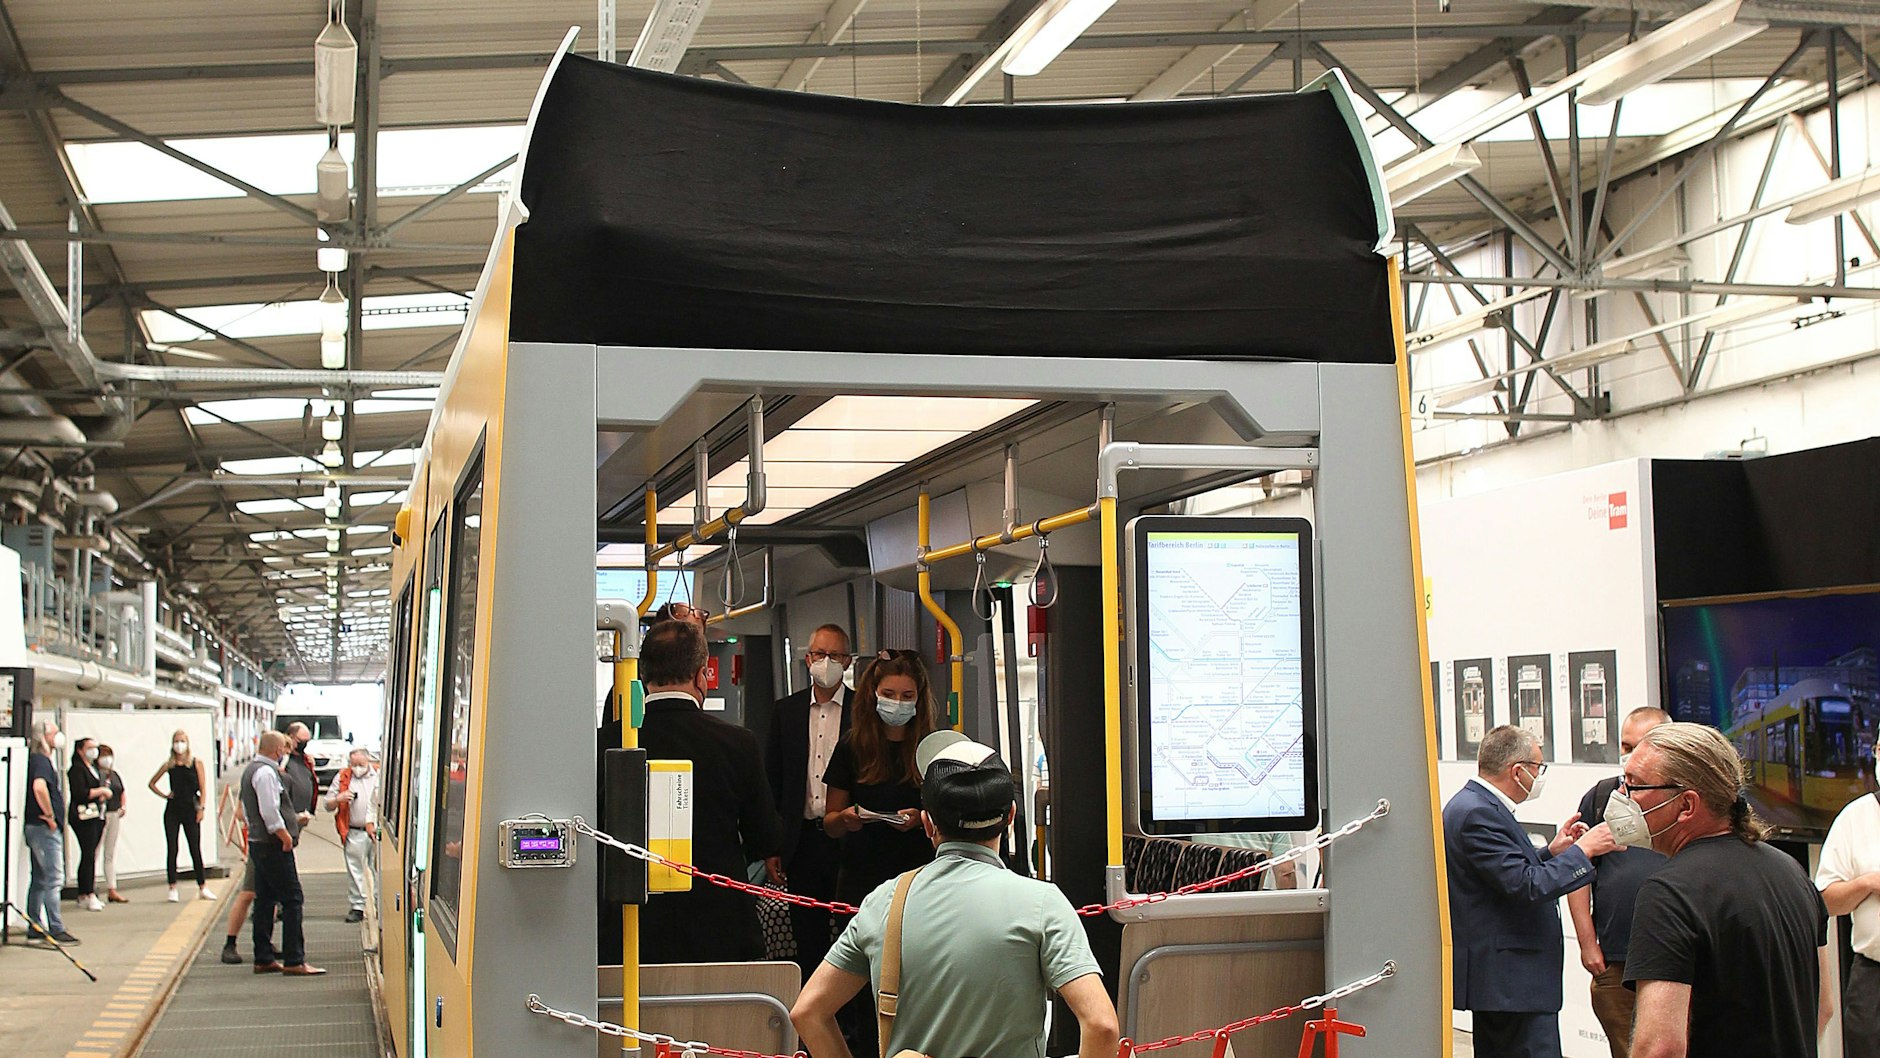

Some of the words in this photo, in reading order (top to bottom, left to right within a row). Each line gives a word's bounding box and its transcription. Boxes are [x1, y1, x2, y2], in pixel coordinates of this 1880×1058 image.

[1418, 394, 1427, 414] 6
[1588, 506, 1607, 520] Deine
[1608, 503, 1627, 518] Tram
[1148, 541, 1184, 549] Tarifbereich
[1185, 541, 1203, 549] Berlin
[1559, 654, 1567, 691] 1934
